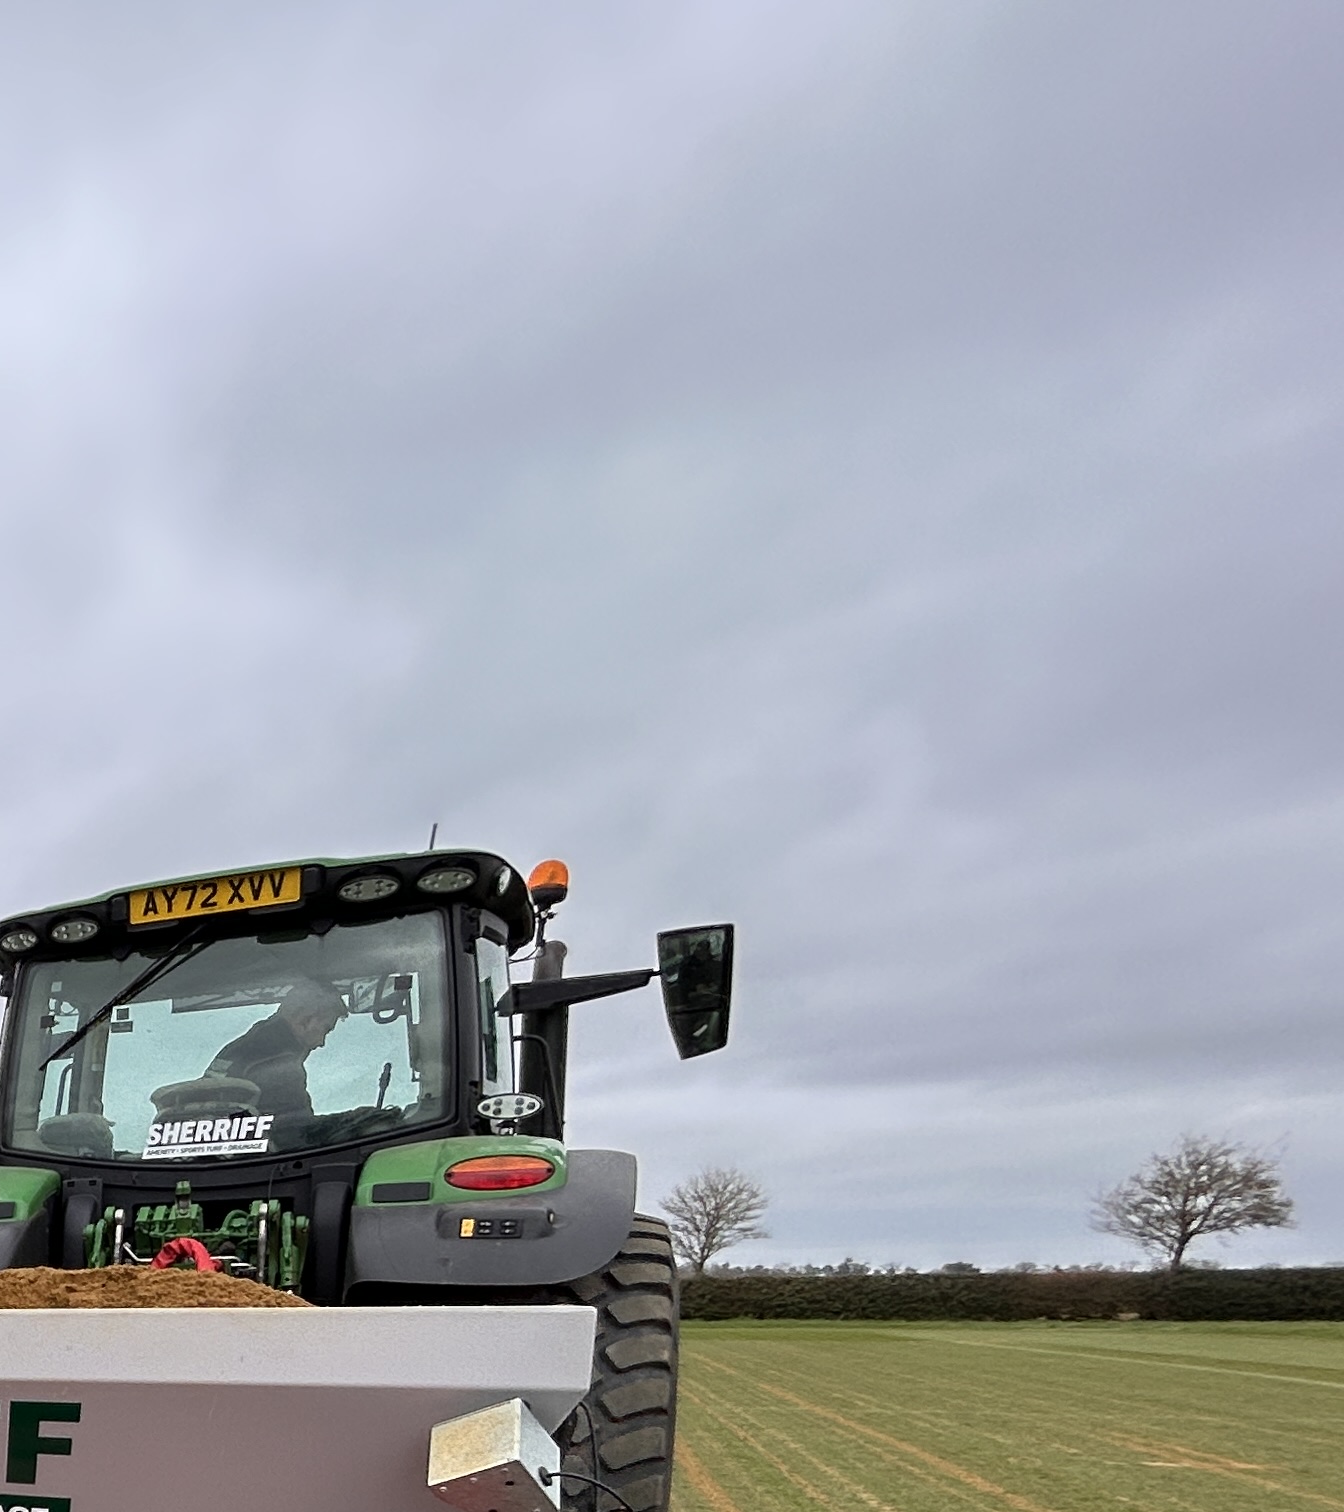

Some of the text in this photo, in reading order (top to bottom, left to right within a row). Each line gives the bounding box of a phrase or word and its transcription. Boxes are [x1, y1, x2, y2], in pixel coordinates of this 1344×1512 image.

[143, 871, 286, 916] AY72 XVV
[146, 1115, 274, 1145] SHERRIFF
